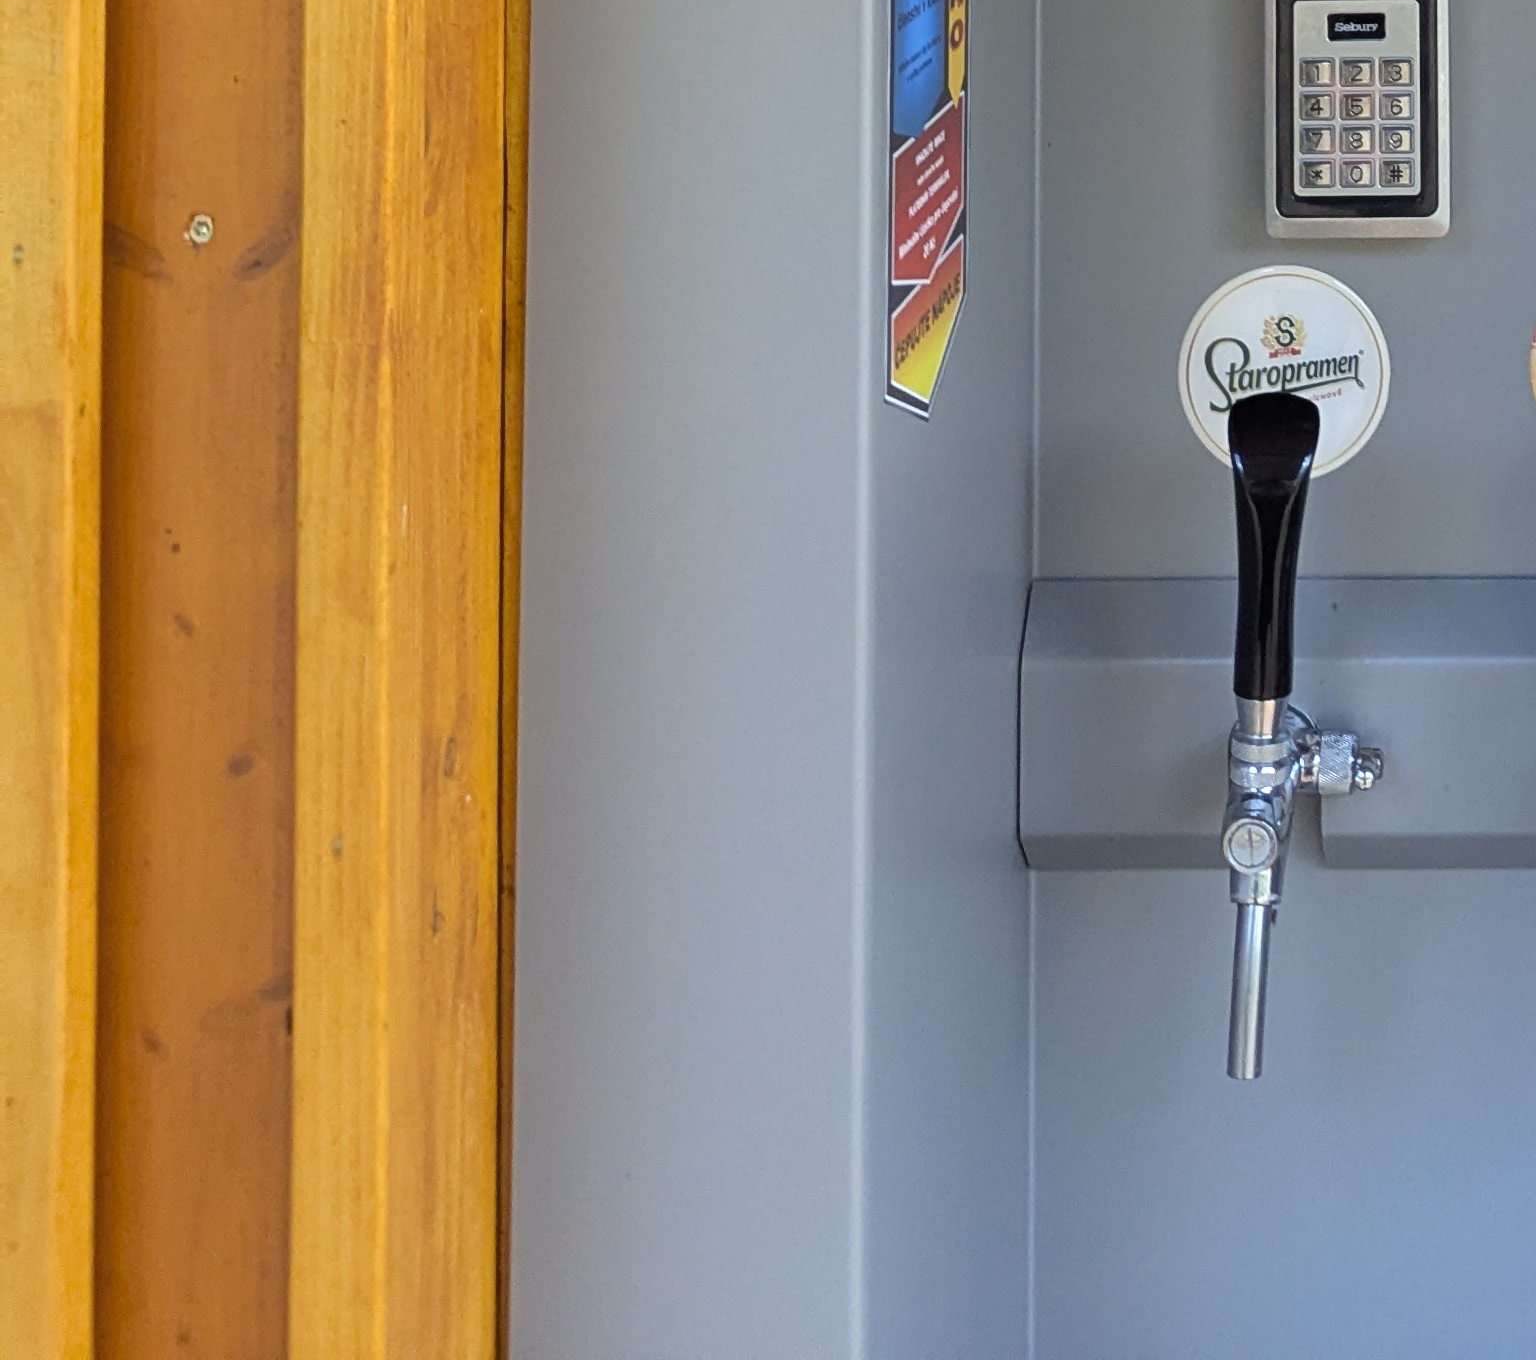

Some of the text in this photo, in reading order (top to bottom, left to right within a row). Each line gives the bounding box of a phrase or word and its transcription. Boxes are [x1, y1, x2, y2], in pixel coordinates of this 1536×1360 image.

[1333, 22, 1379, 33] Sebury
[1350, 65, 1364, 82] 2
[1390, 65, 1403, 82] 3
[1309, 98, 1404, 116] 4 5 6
[1311, 132, 1404, 149] 7 8 9
[1350, 165, 1364, 183] 0
[1204, 336, 1365, 413] Staropramen
